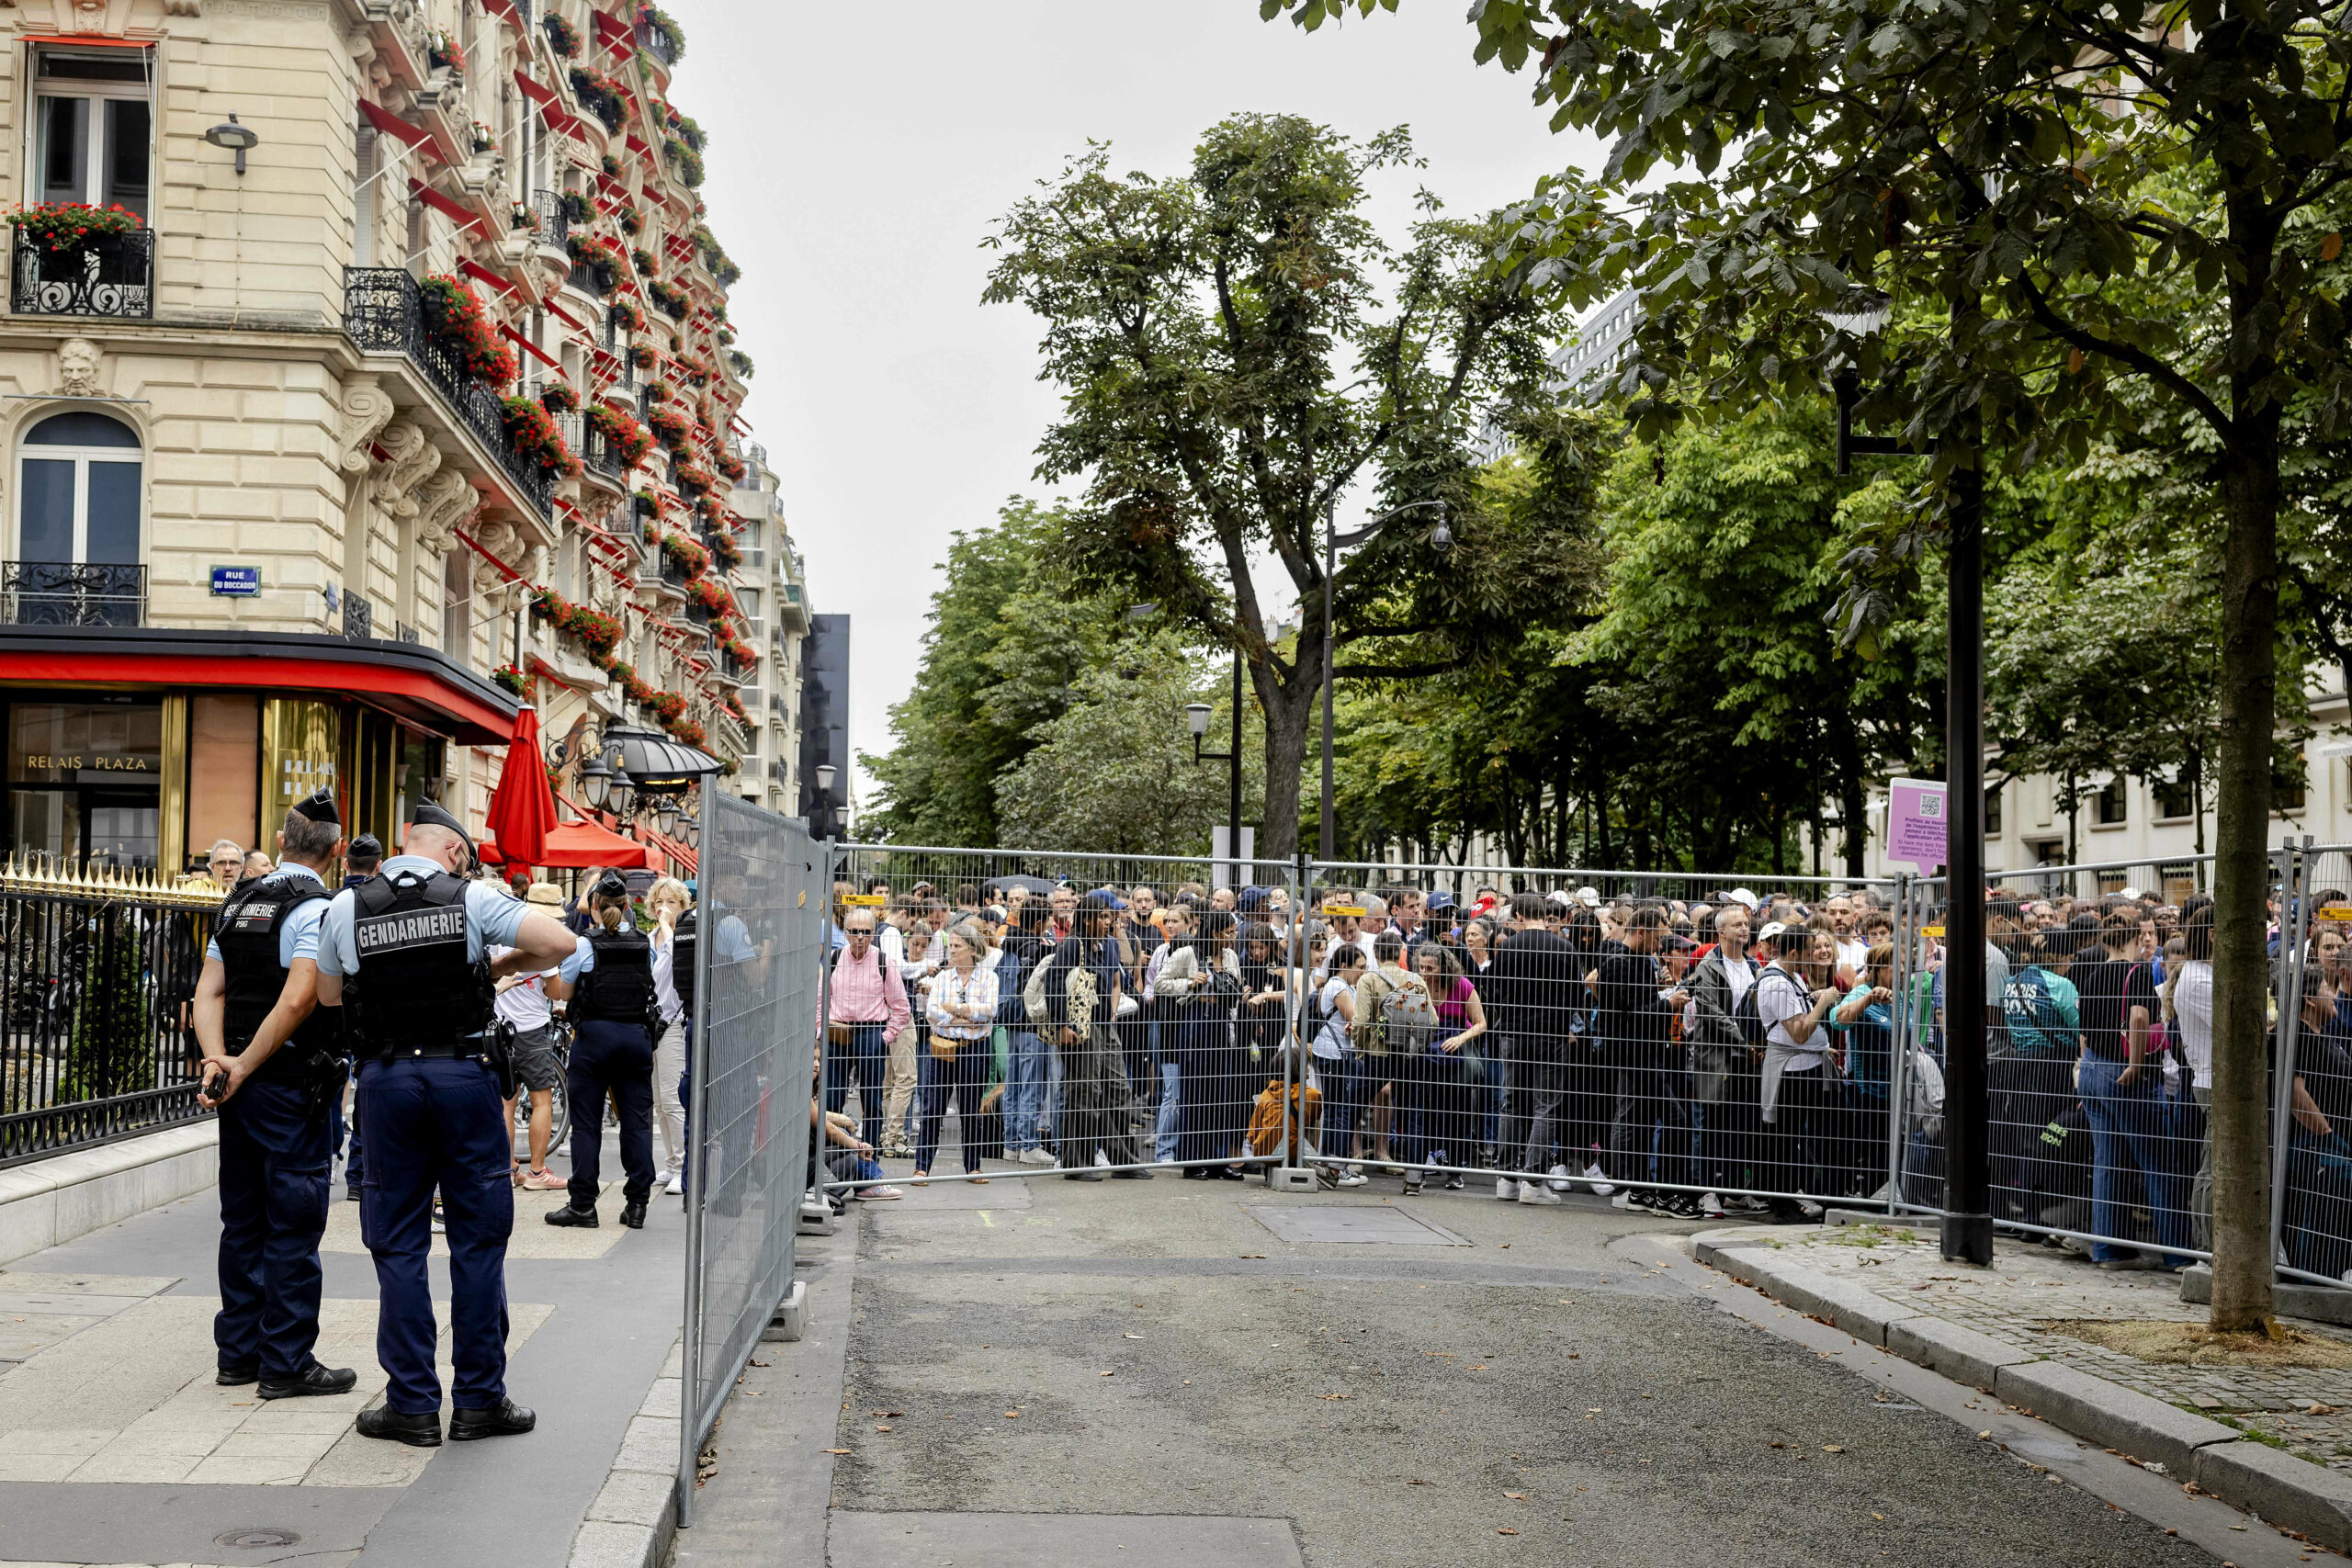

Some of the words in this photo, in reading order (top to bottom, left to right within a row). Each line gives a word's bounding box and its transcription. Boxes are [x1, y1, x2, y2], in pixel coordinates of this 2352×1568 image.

[226, 571, 244, 580] RUE
[28, 755, 83, 769] RELAIS
[95, 756, 147, 770] PLAZA
[224, 904, 276, 917] GENARMERIE
[235, 919, 248, 929] PSIG
[357, 912, 464, 948] GENDARMERIE
[2004, 983, 2038, 999] PARIS
